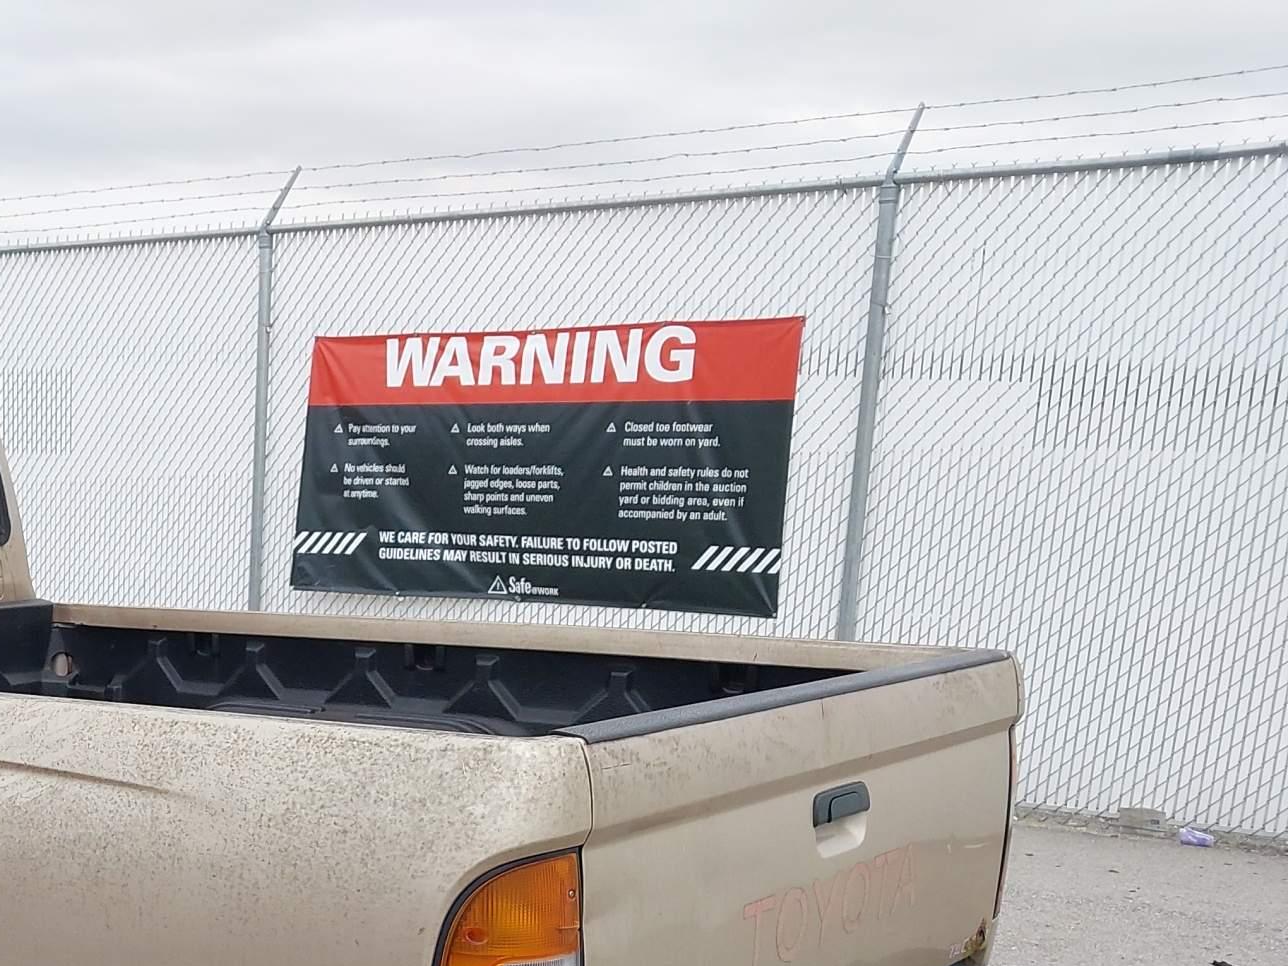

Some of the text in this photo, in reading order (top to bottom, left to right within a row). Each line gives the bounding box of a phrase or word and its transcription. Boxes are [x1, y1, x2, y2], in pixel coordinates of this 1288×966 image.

[386, 325, 697, 388] WARNING
[348, 424, 416, 435] Pay attention to your
[467, 423, 550, 434] Look both ways when
[624, 421, 713, 432] Closed toe footwear
[466, 436, 524, 448] crossing aisles.
[623, 436, 721, 448] must be worn on yard.
[344, 463, 406, 473] No vehicles should
[464, 464, 564, 476] Watch for loaders/forklifts,
[620, 465, 749, 479] Health and safety rules do not
[343, 476, 410, 486] be driven or started
[463, 478, 561, 491] jagged edges, loose parts,
[619, 479, 747, 493] permit children in the auction
[464, 492, 554, 503] sharp points and uneven
[619, 494, 745, 507] yard or bidding area, even if
[463, 504, 527, 516] walking surfaces.
[618, 509, 728, 522] accompanied by an adult.
[379, 531, 678, 555] WE CARE FOR YOUR SAFETY. FAILURE TO FOLLOW POSTED
[379, 548, 676, 572] GUIDELINES MAY RESULT IN SERIOUS INJURY OR DEATH.
